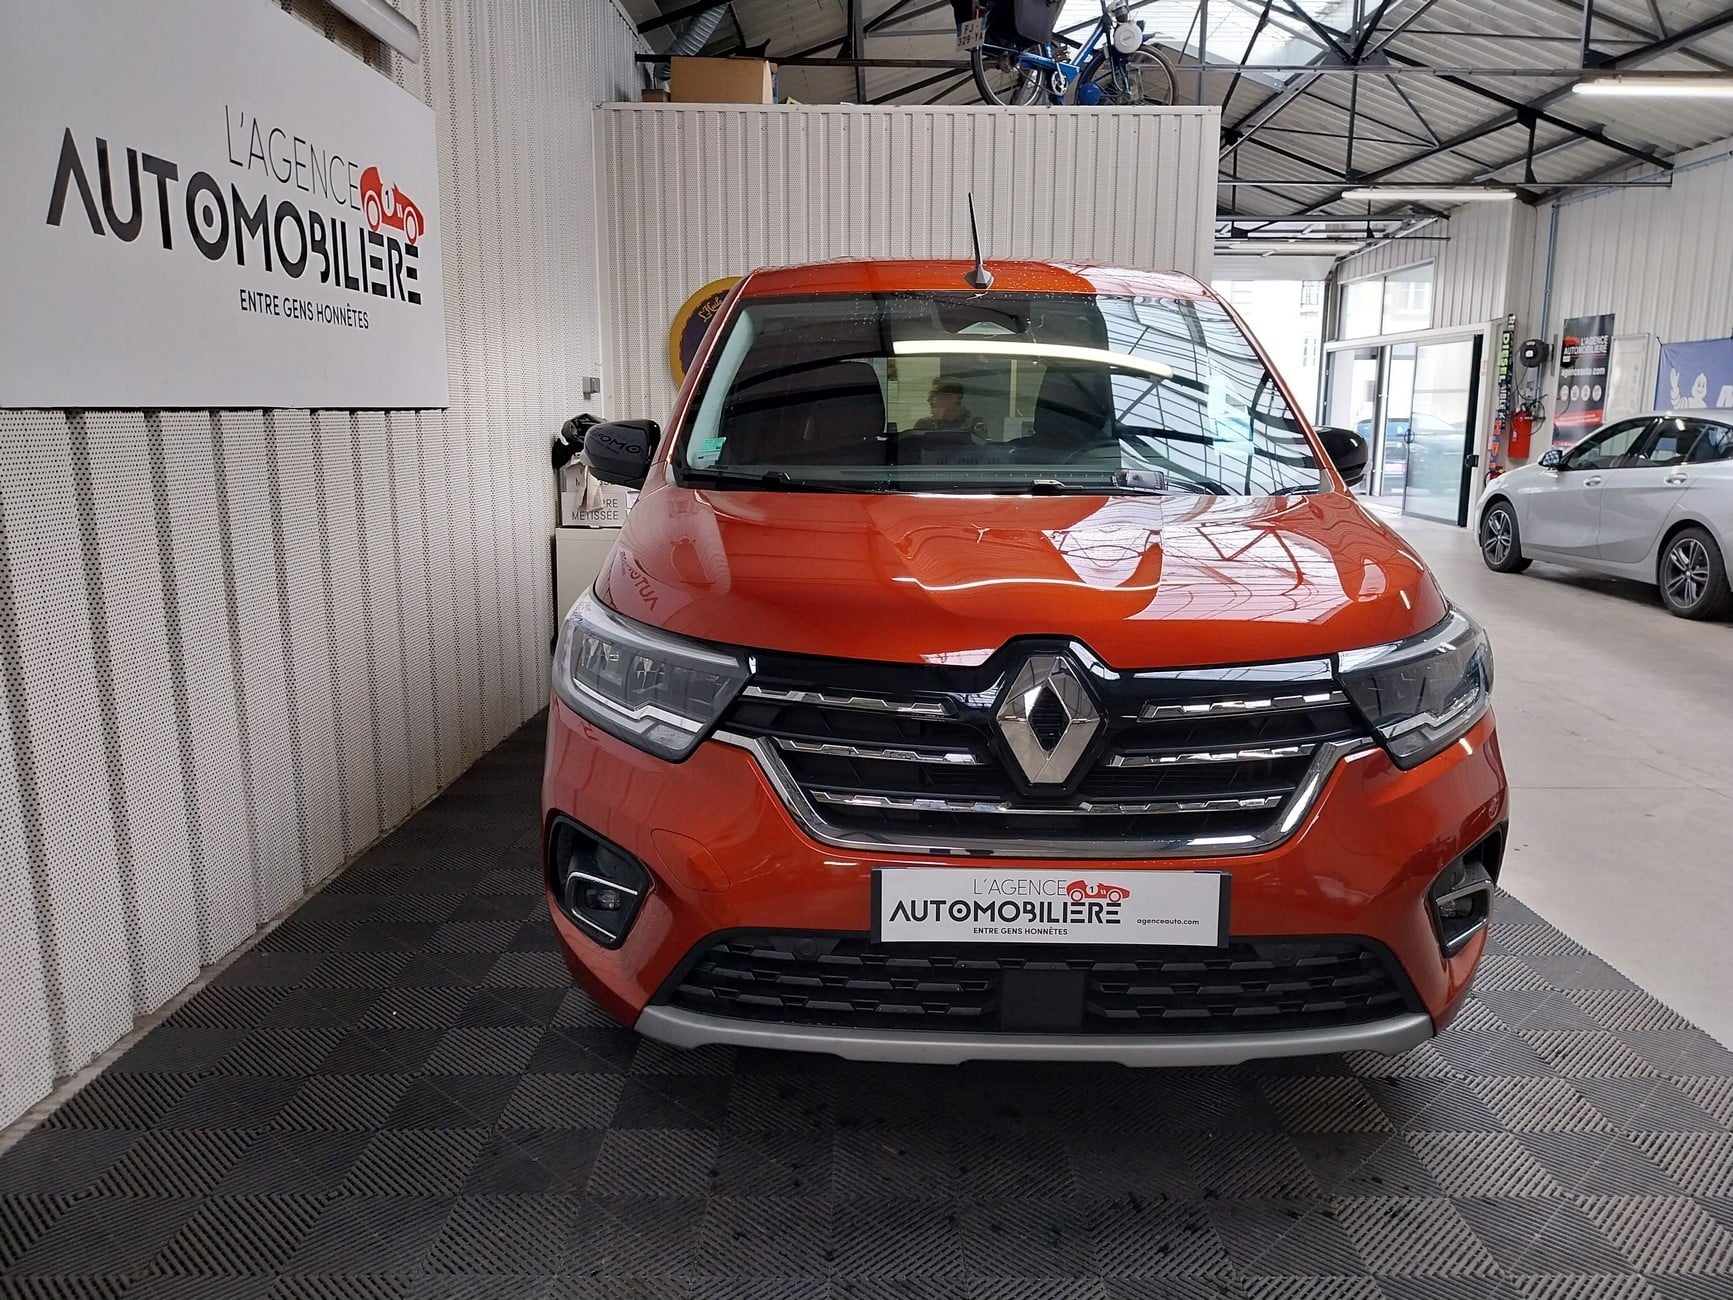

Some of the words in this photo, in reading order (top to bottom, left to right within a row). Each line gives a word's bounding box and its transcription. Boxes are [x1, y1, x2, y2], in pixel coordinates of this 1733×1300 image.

[225, 104, 361, 211] L'AGENCE
[239, 288, 280, 316] ENTRE
[282, 297, 314, 321] GENS
[316, 302, 370, 330] HONNÊTES
[1498, 332, 1511, 384] DIESEL
[973, 878, 1068, 897] L'AGENCE
[973, 927, 999, 936] ENTRE
[1000, 927, 1023, 936] GENS
[1024, 925, 1068, 936] HONNÊTES
[1136, 918, 1200, 927] agenceauto.com
